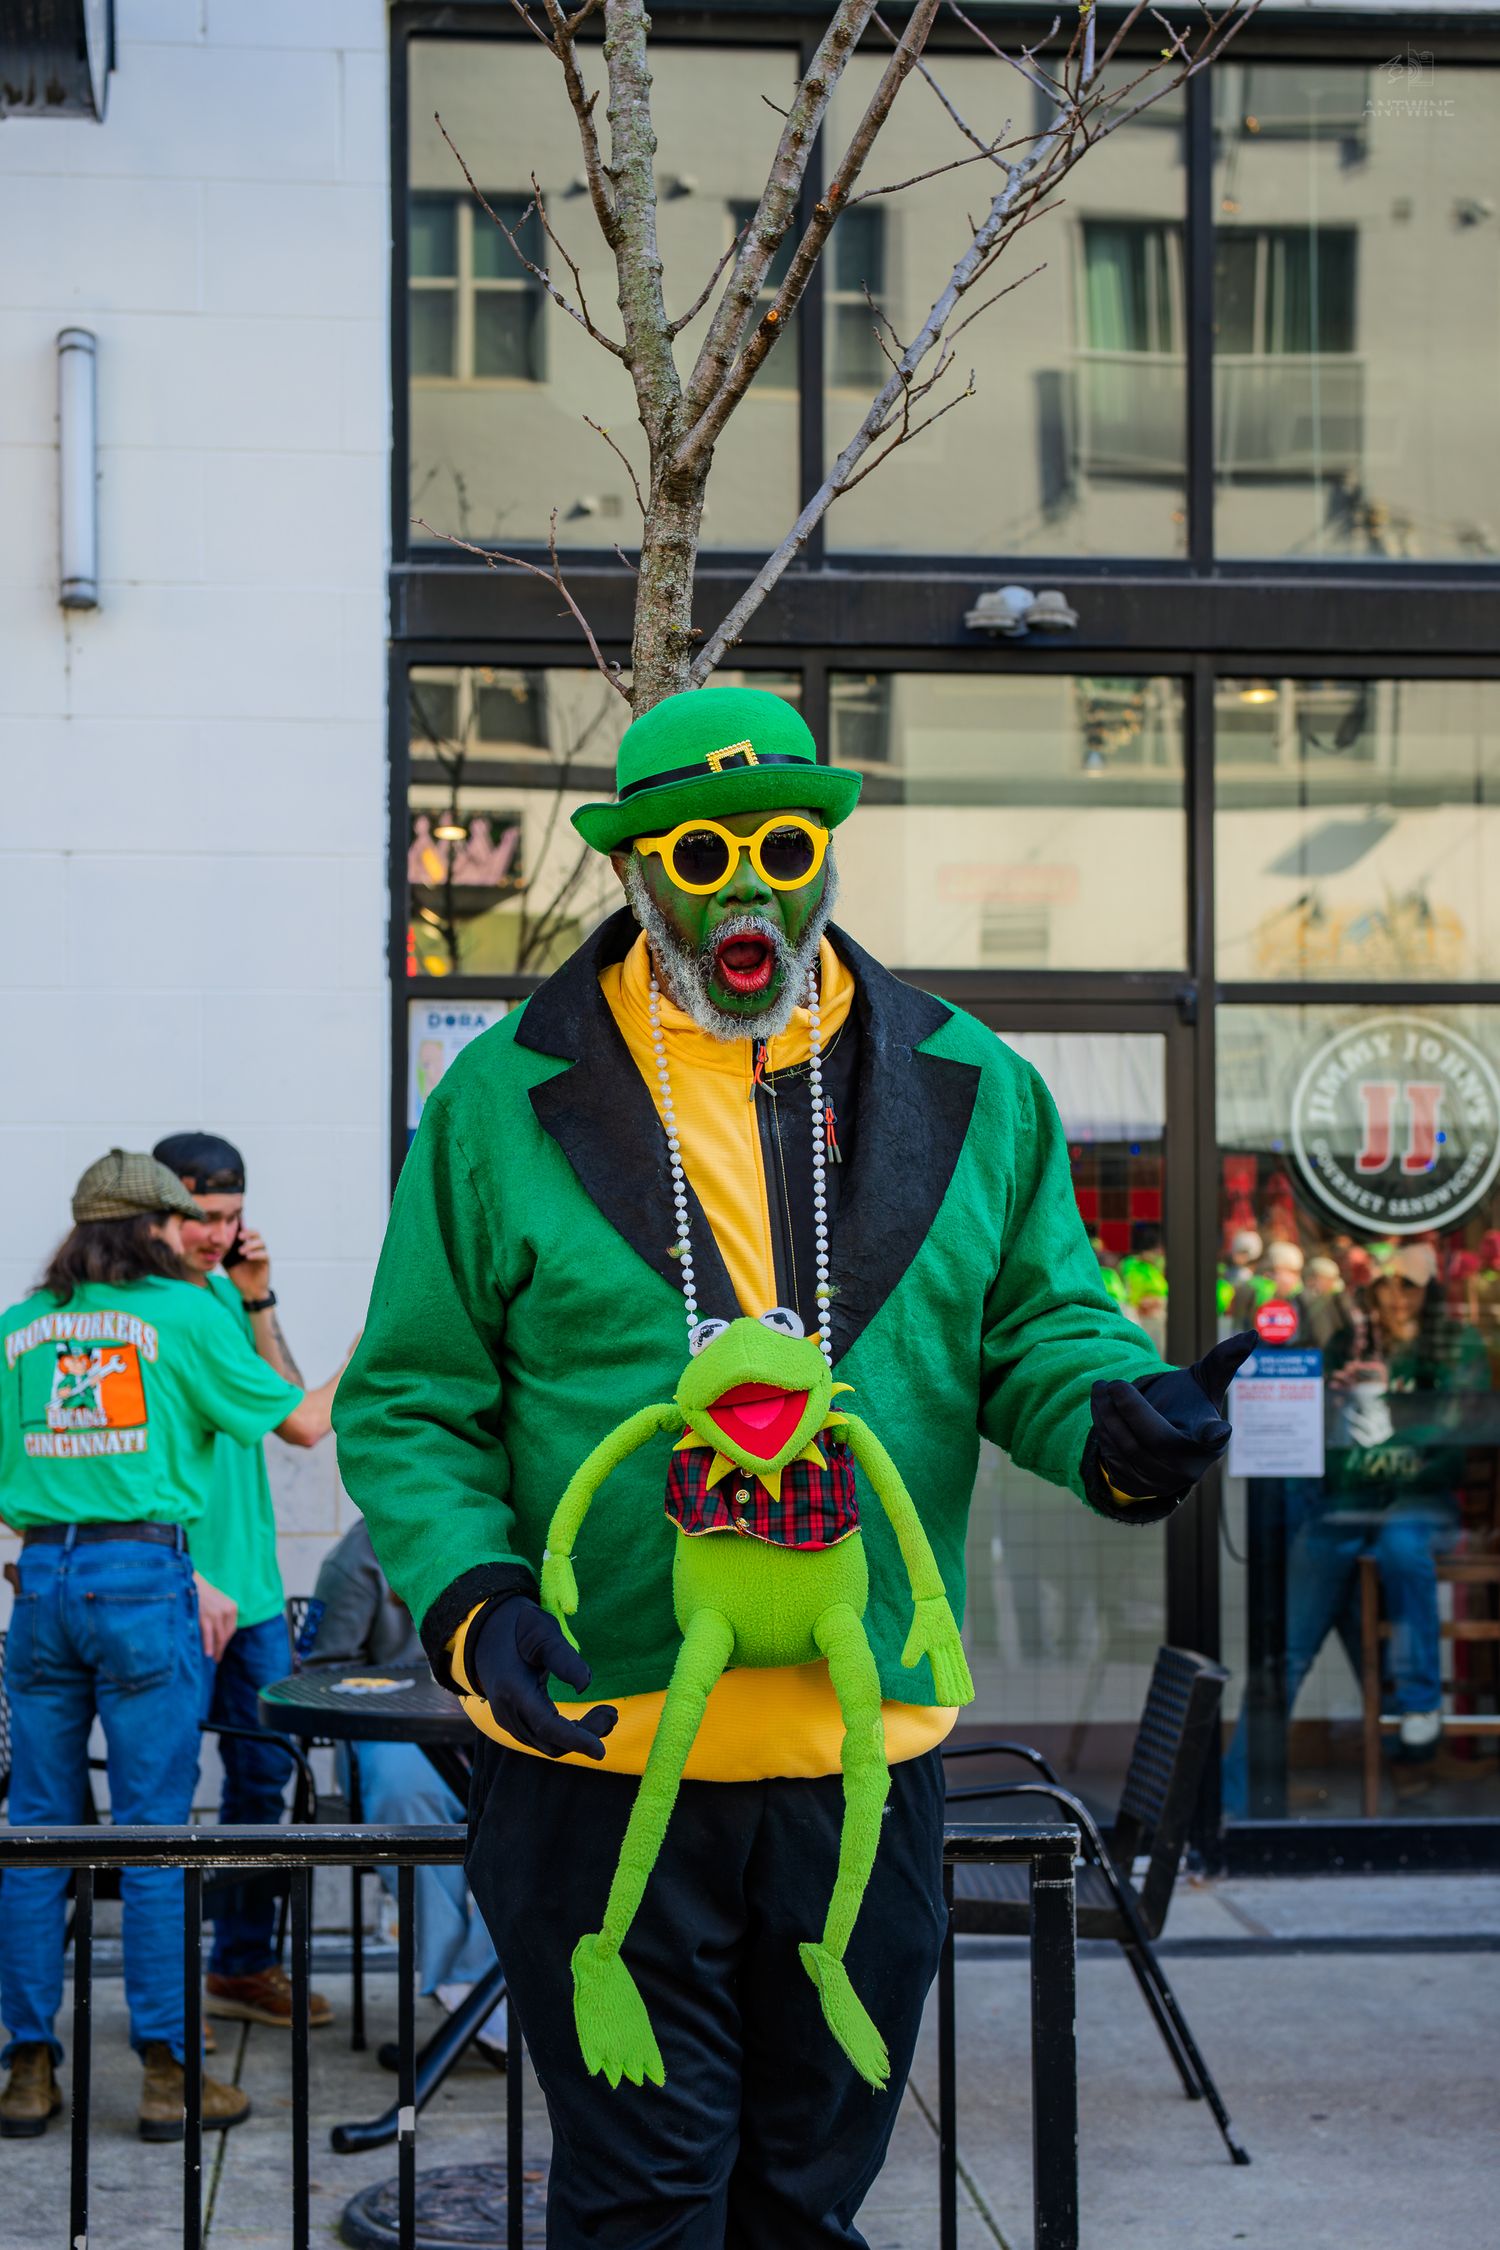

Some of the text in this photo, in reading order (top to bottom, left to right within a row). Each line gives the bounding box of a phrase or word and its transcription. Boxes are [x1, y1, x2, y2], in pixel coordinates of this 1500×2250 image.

[1308, 1032, 1490, 1126] JIMMY JOHN'S
[1355, 1079, 1446, 1175] JJ
[1311, 1138, 1385, 1213] GOURMET
[5, 1310, 158, 1371] IRONWORKERS
[24, 1428, 147, 1458] CINCINNATI
